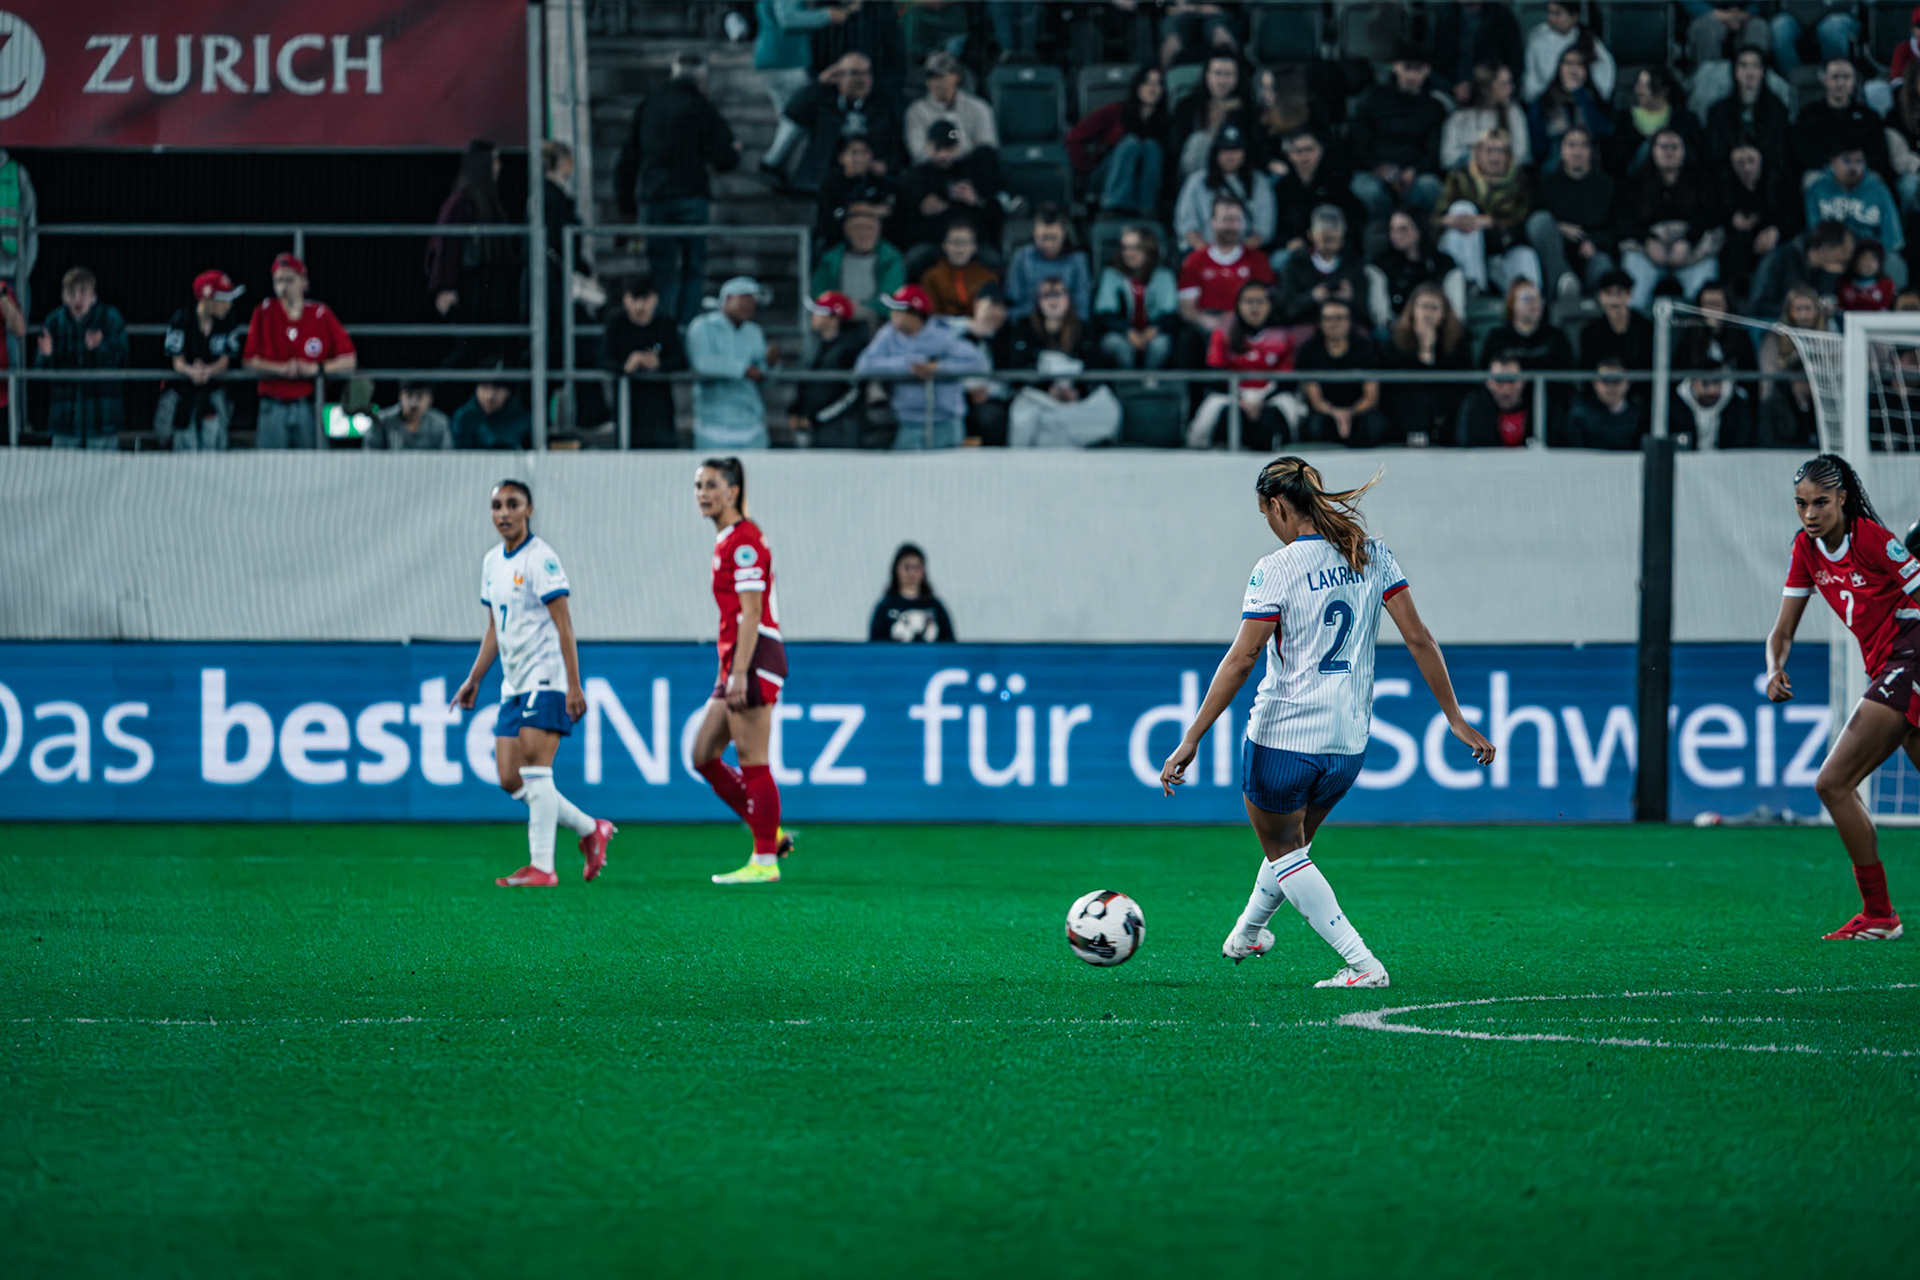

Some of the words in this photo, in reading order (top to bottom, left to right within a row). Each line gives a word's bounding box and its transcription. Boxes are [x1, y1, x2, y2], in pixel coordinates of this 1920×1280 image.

[82, 33, 383, 95] ZURICH
[499, 604, 508, 633] 7
[1318, 599, 1355, 675] 2
[0, 680, 155, 784] as
[907, 668, 1092, 788] für
[1128, 669, 1247, 788] di
